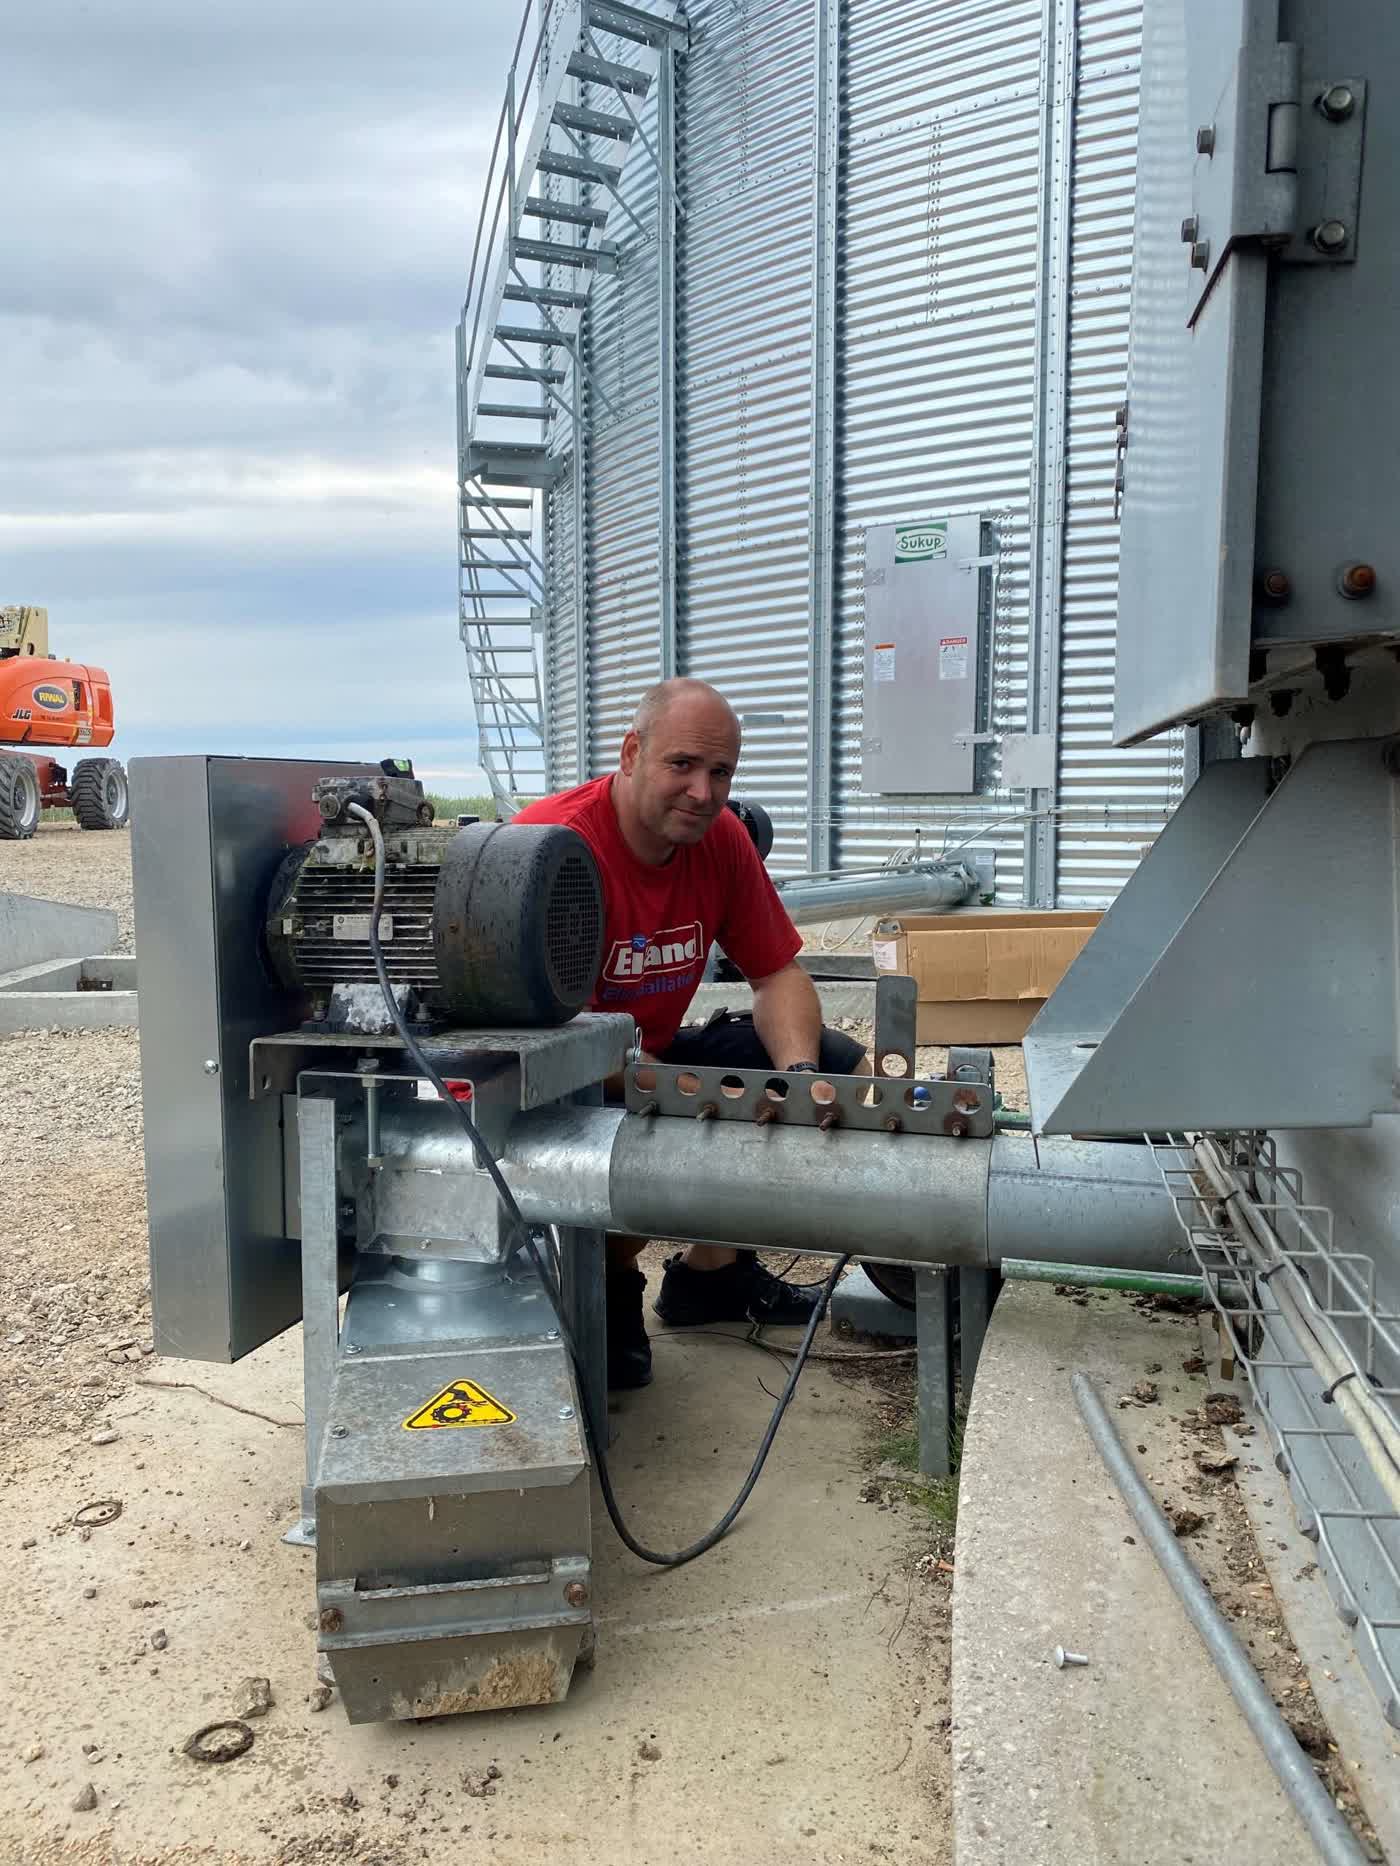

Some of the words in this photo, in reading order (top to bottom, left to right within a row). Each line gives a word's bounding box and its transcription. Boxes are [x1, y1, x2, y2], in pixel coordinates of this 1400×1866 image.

[901, 534, 941, 550] Sukup
[39, 692, 65, 704] RIWAL
[12, 709, 32, 720] JLG
